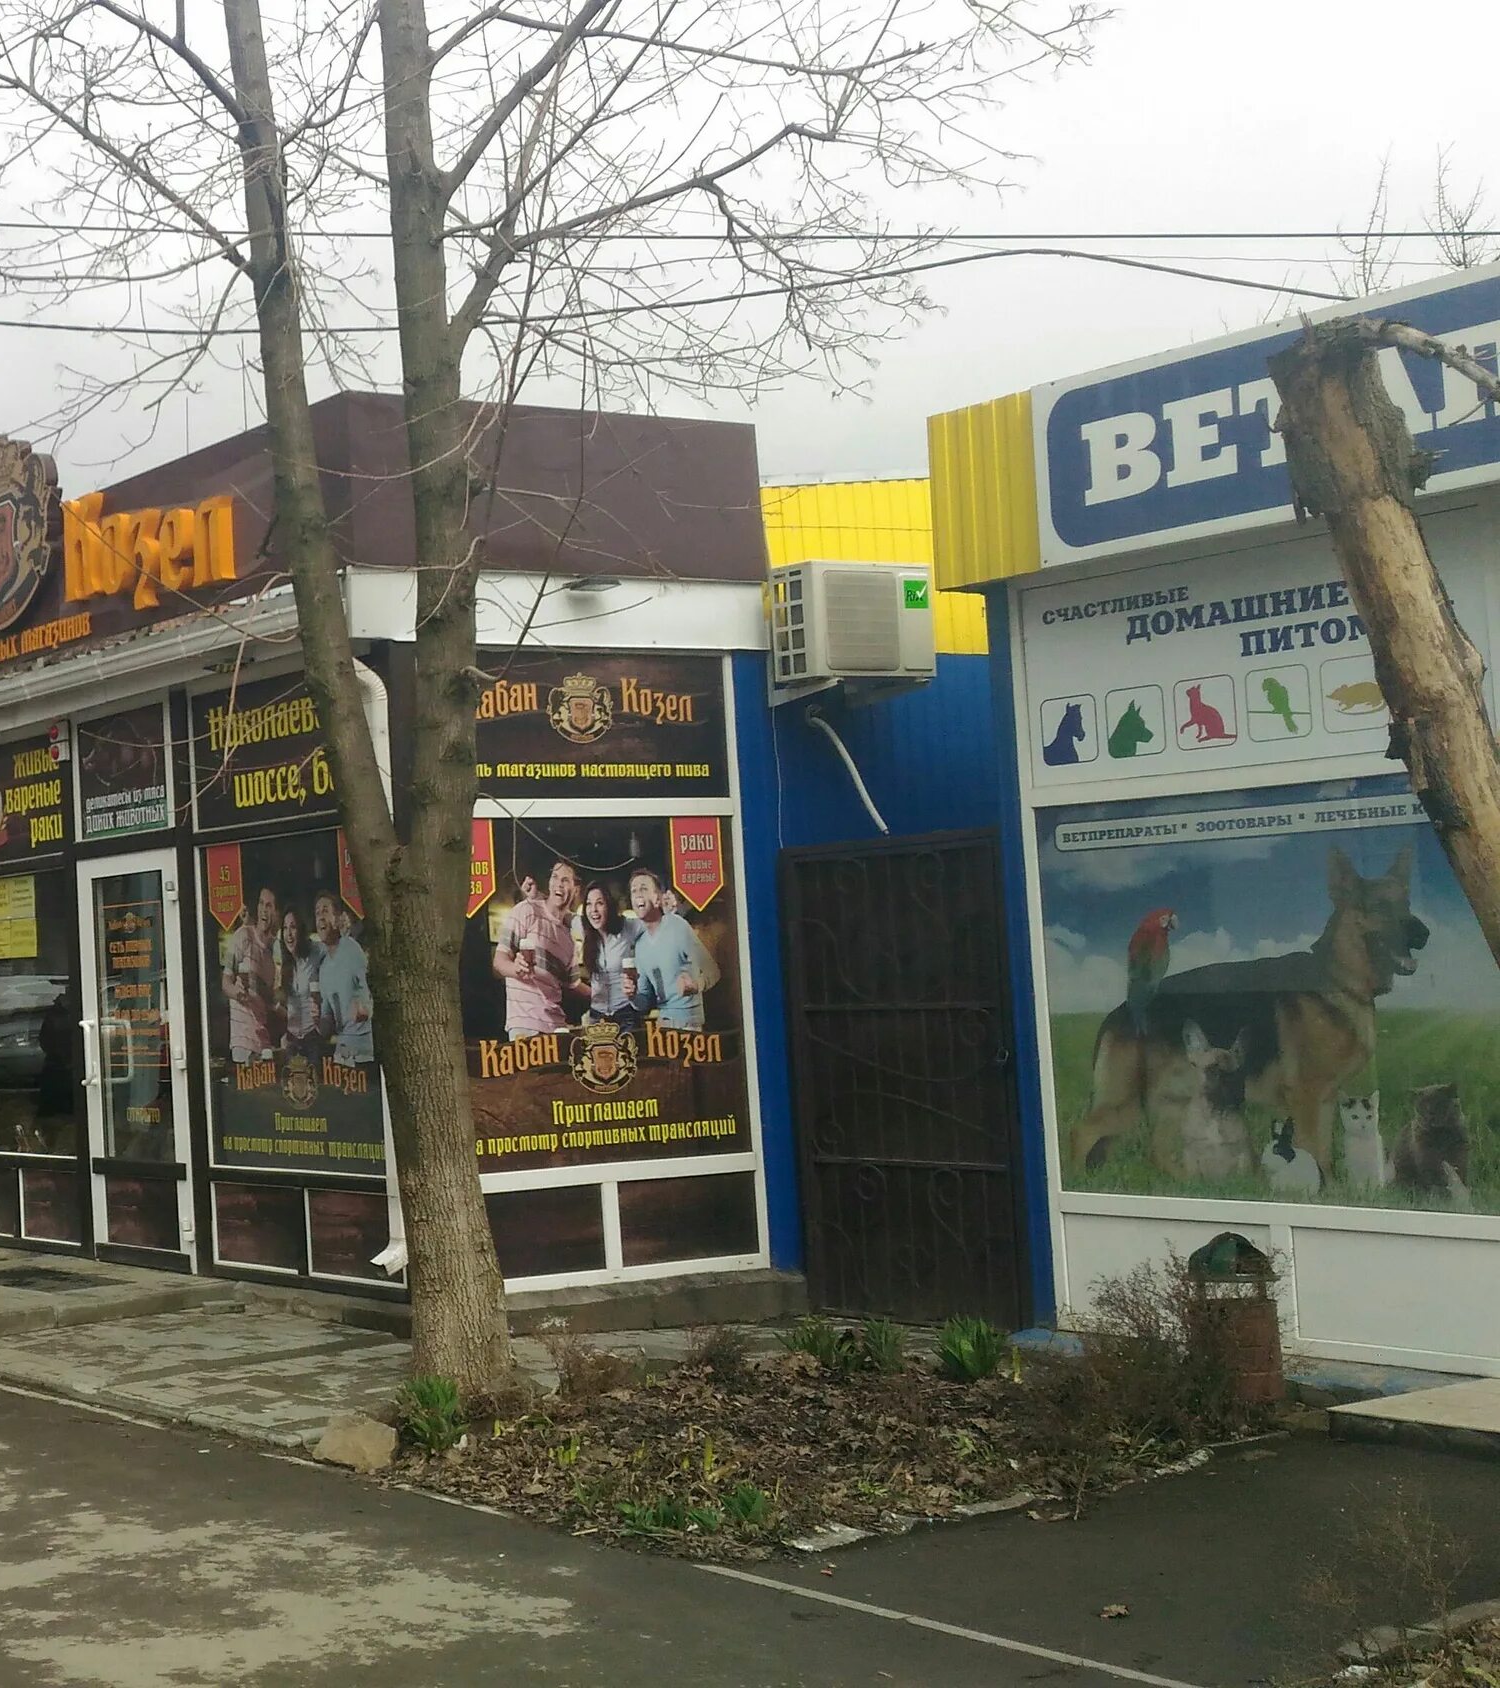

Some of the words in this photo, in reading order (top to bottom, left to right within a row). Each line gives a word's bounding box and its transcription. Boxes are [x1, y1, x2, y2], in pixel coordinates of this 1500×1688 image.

[60, 492, 237, 610] Козел
[1042, 586, 1189, 625] СЧАСТЛИВЫЕ
[1126, 580, 1349, 645] ДОМАШНИЕ
[20, 611, 92, 654] магазинов
[475, 680, 538, 720] абан
[620, 677, 693, 724] Козел
[208, 697, 320, 751] Николаев
[234, 764, 307, 807] шоссе,
[496, 763, 575, 779] магазинов
[580, 763, 672, 780] настоящего
[675, 763, 710, 777] пива
[5, 779, 61, 815] вареные
[29, 813, 63, 848] раки
[680, 833, 714, 855] раки
[1062, 823, 1178, 843] ВЕТПРЕПАРАТЫ
[1196, 814, 1293, 833] ЗООТОВАРЫ
[1314, 805, 1407, 823] ЛЕЧЕБНЫЕ
[479, 1031, 560, 1079] Кабан
[644, 1019, 723, 1067] Козел
[236, 1059, 276, 1091] Кабан
[322, 1056, 367, 1095] Козел
[551, 1098, 659, 1127] Приглашаем
[488, 1131, 558, 1157] просмотр
[562, 1124, 646, 1150] спортивных
[648, 1113, 736, 1144] трансляций
